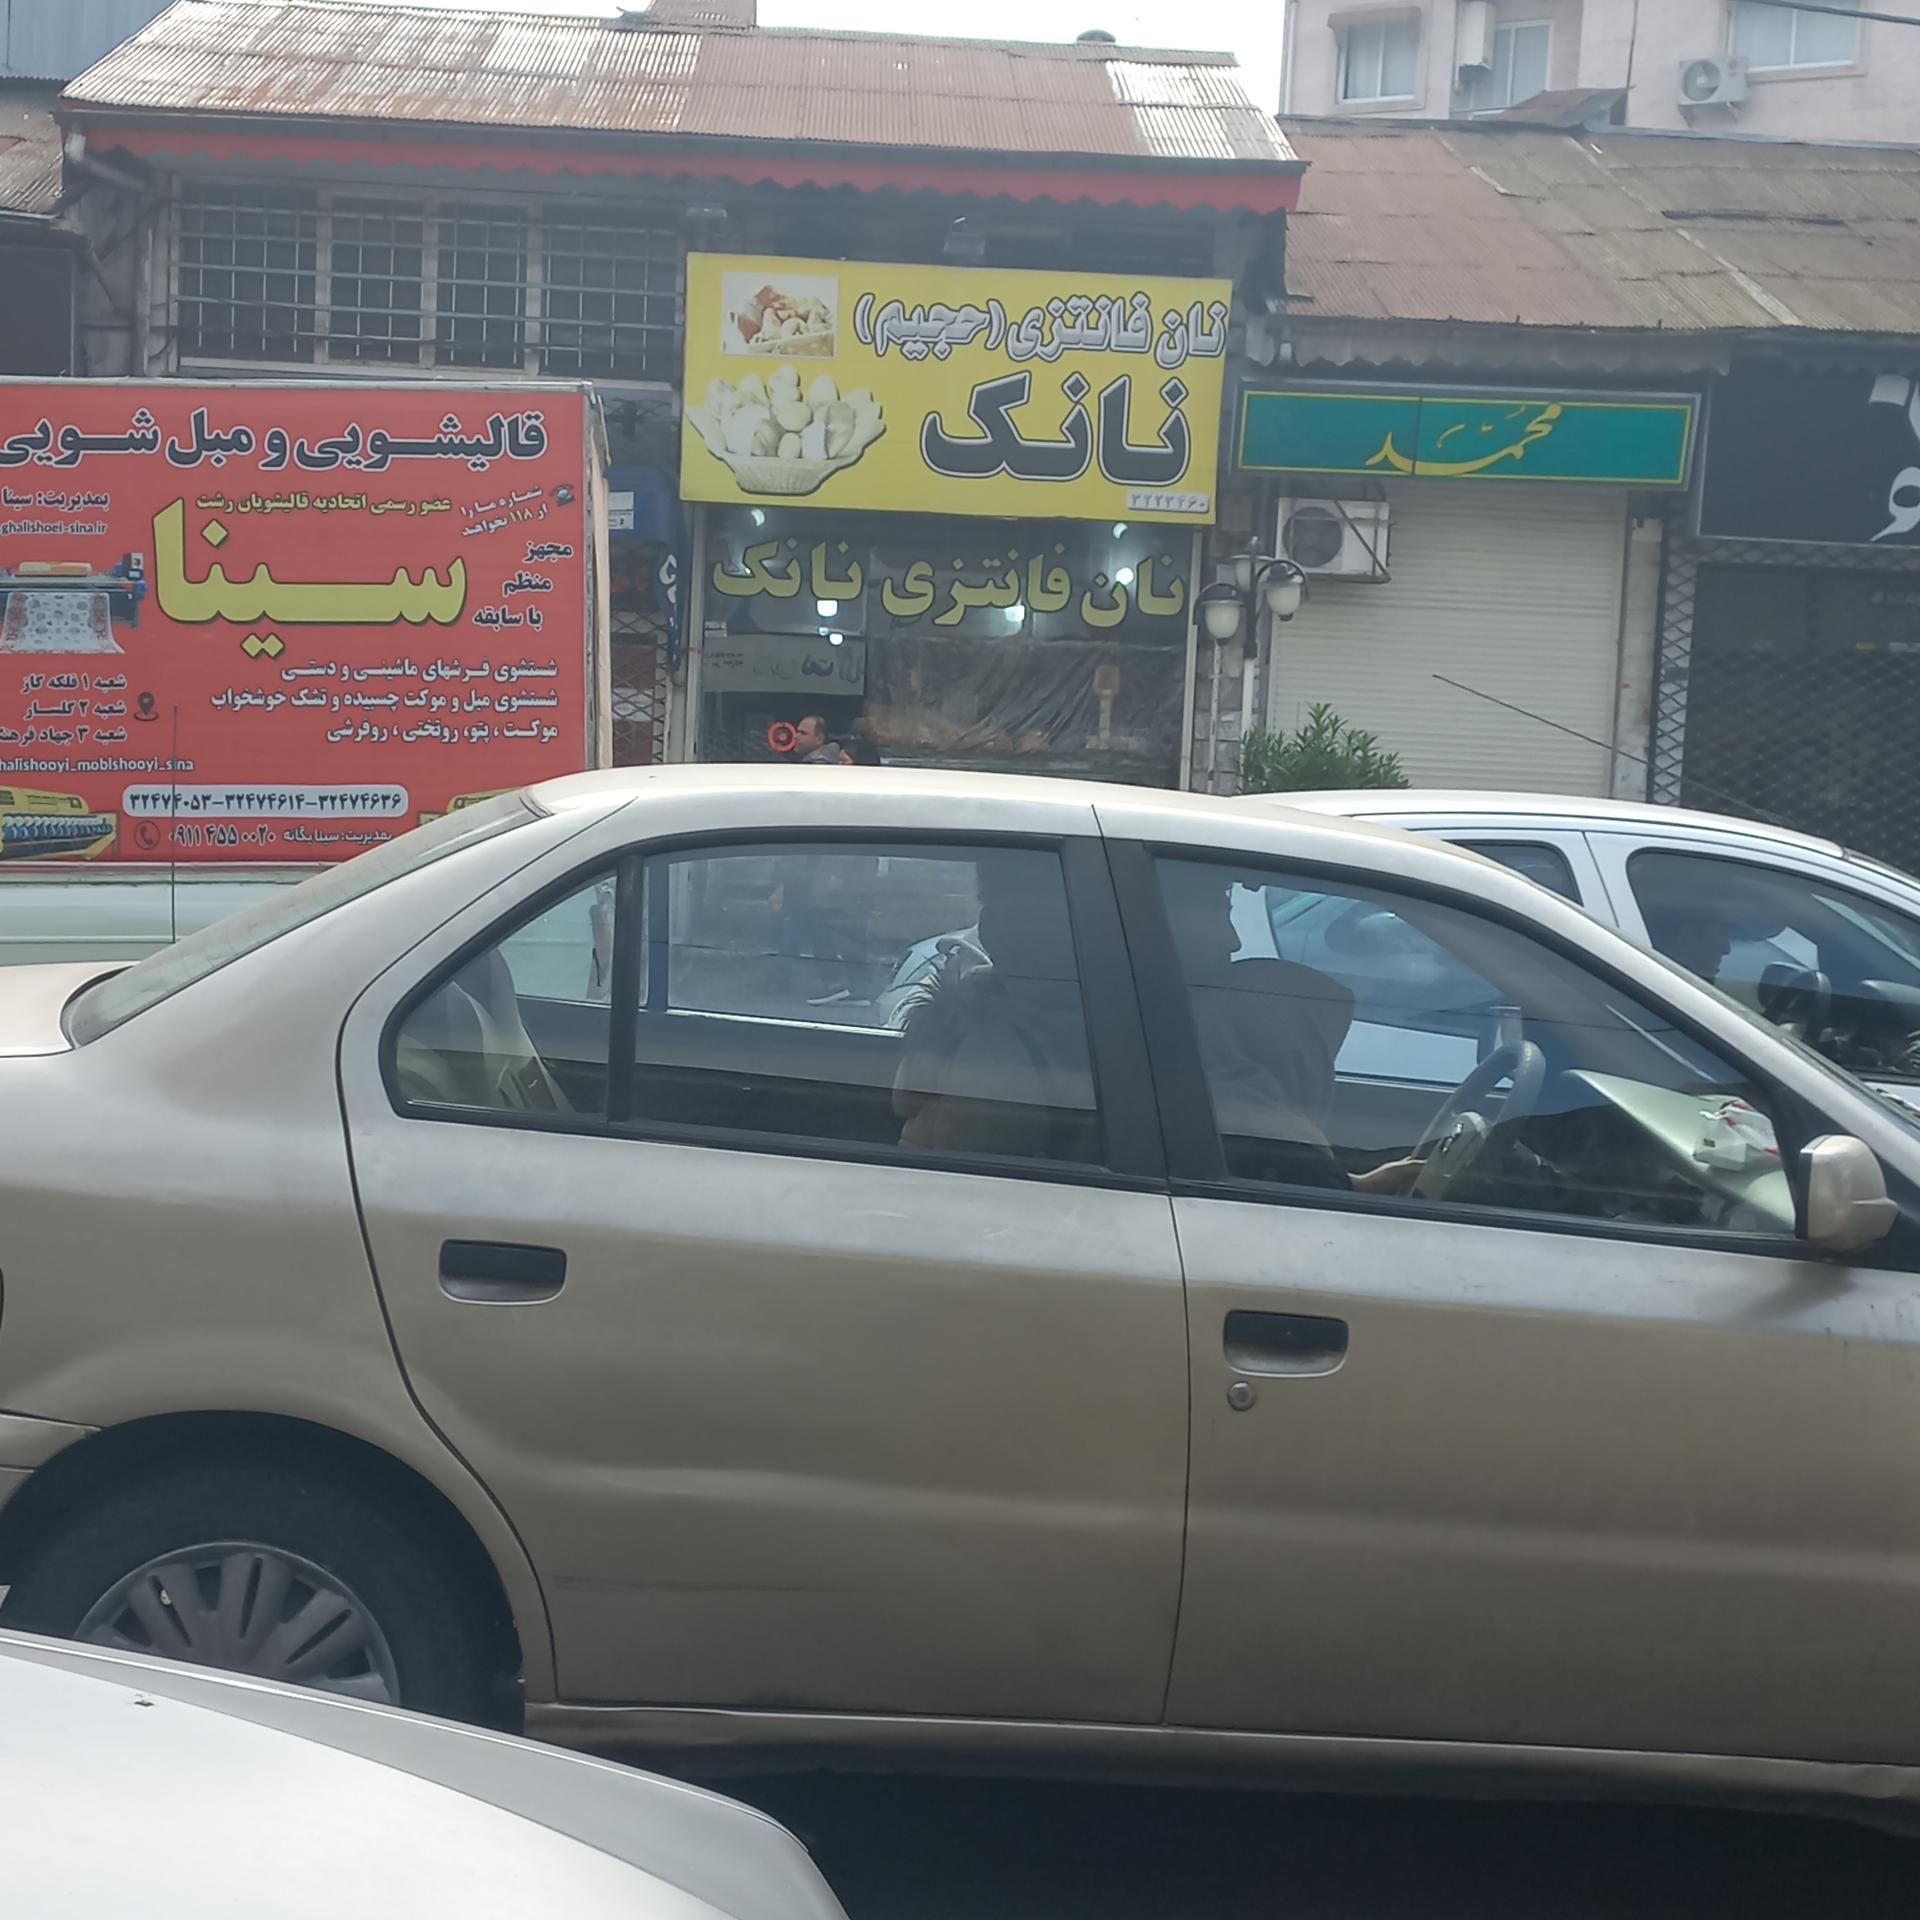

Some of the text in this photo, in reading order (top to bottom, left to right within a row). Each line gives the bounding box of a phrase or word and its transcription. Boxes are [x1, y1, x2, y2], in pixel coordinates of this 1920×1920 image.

[854, 291, 1227, 369] نان فانتزی (حجیم)
[0, 406, 547, 472] قالیشویی و مبل شویی
[920, 370, 1191, 486] نانک
[196, 492, 451, 517] عضو رسمی اتحادیه قالیشویان رشت
[510, 507, 533, 523] ۱۱۸
[522, 541, 573, 562] مجهز
[152, 497, 468, 660] سینا
[503, 570, 553, 597] منظم
[713, 538, 1184, 627] نان فانتزی نانک
[472, 605, 543, 632] با سابقه
[48, 674, 78, 689] فلکه
[281, 657, 558, 682] شستشوی فرشهای ماشینی و دستی
[81, 674, 90, 691] ۱
[94, 674, 127, 693] شعبه
[78, 700, 89, 717] ۲
[94, 700, 127, 719] شعبه
[210, 687, 558, 712] شستشوی مبل و موکت چسبیده و تشک خوشخواب
[39, 726, 73, 746] جهاد
[77, 726, 88, 744] ۳
[95, 726, 127, 746] شعبه
[327, 718, 388, 742] روفرشی
[204, 822, 239, 847] ۴۵۵
